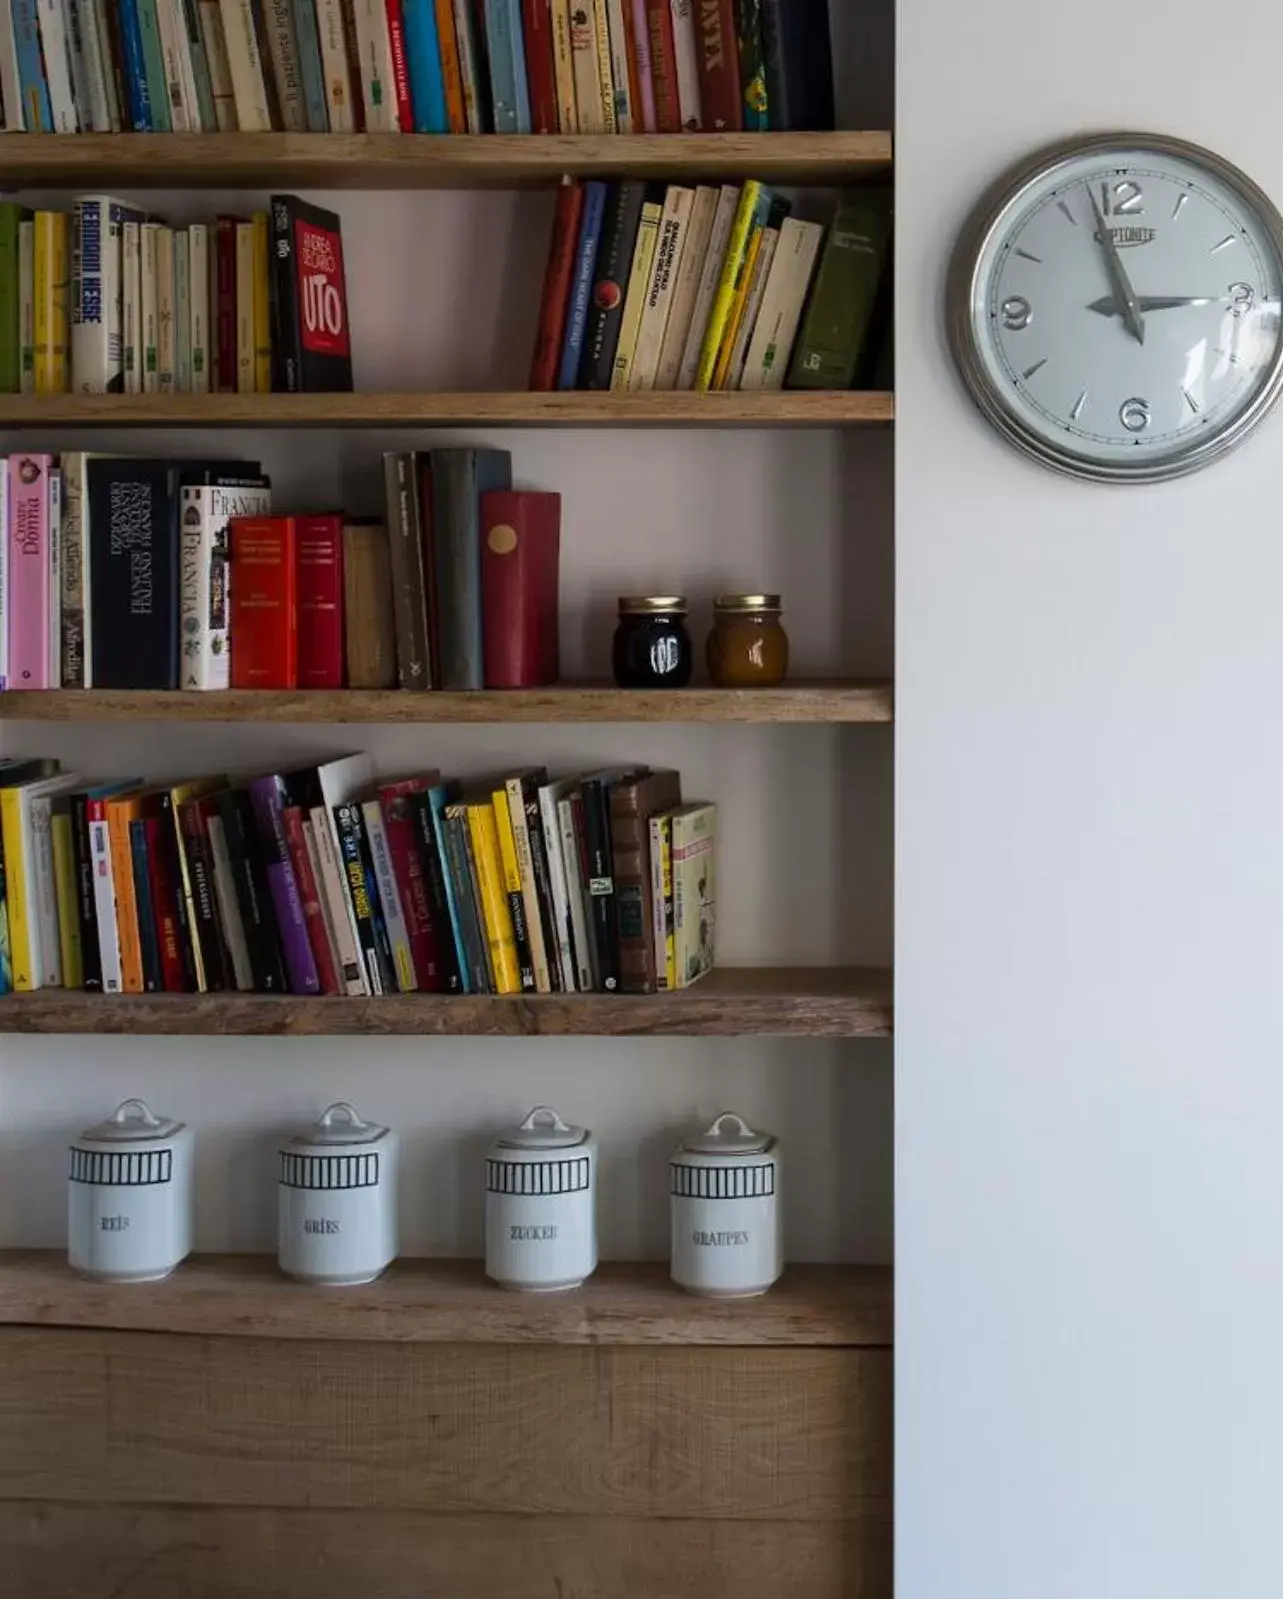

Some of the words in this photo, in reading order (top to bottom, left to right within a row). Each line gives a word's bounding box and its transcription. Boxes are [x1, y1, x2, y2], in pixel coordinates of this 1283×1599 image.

[1101, 181, 1144, 216] 12
[82, 277, 101, 324] HESSE
[303, 273, 341, 335] UTO
[1001, 295, 1031, 331] 9
[1226, 282, 1254, 317] 3
[593, 312, 607, 359] ENIGMA
[1118, 397, 1150, 432] 6
[23, 498, 39, 555] Donna
[182, 531, 202, 615] FRANCIA
[100, 1215, 131, 1232] REIS
[304, 1217, 339, 1235] GRIES
[510, 1226, 558, 1241] ZUCKER
[693, 1231, 749, 1246] GRAUPEN
